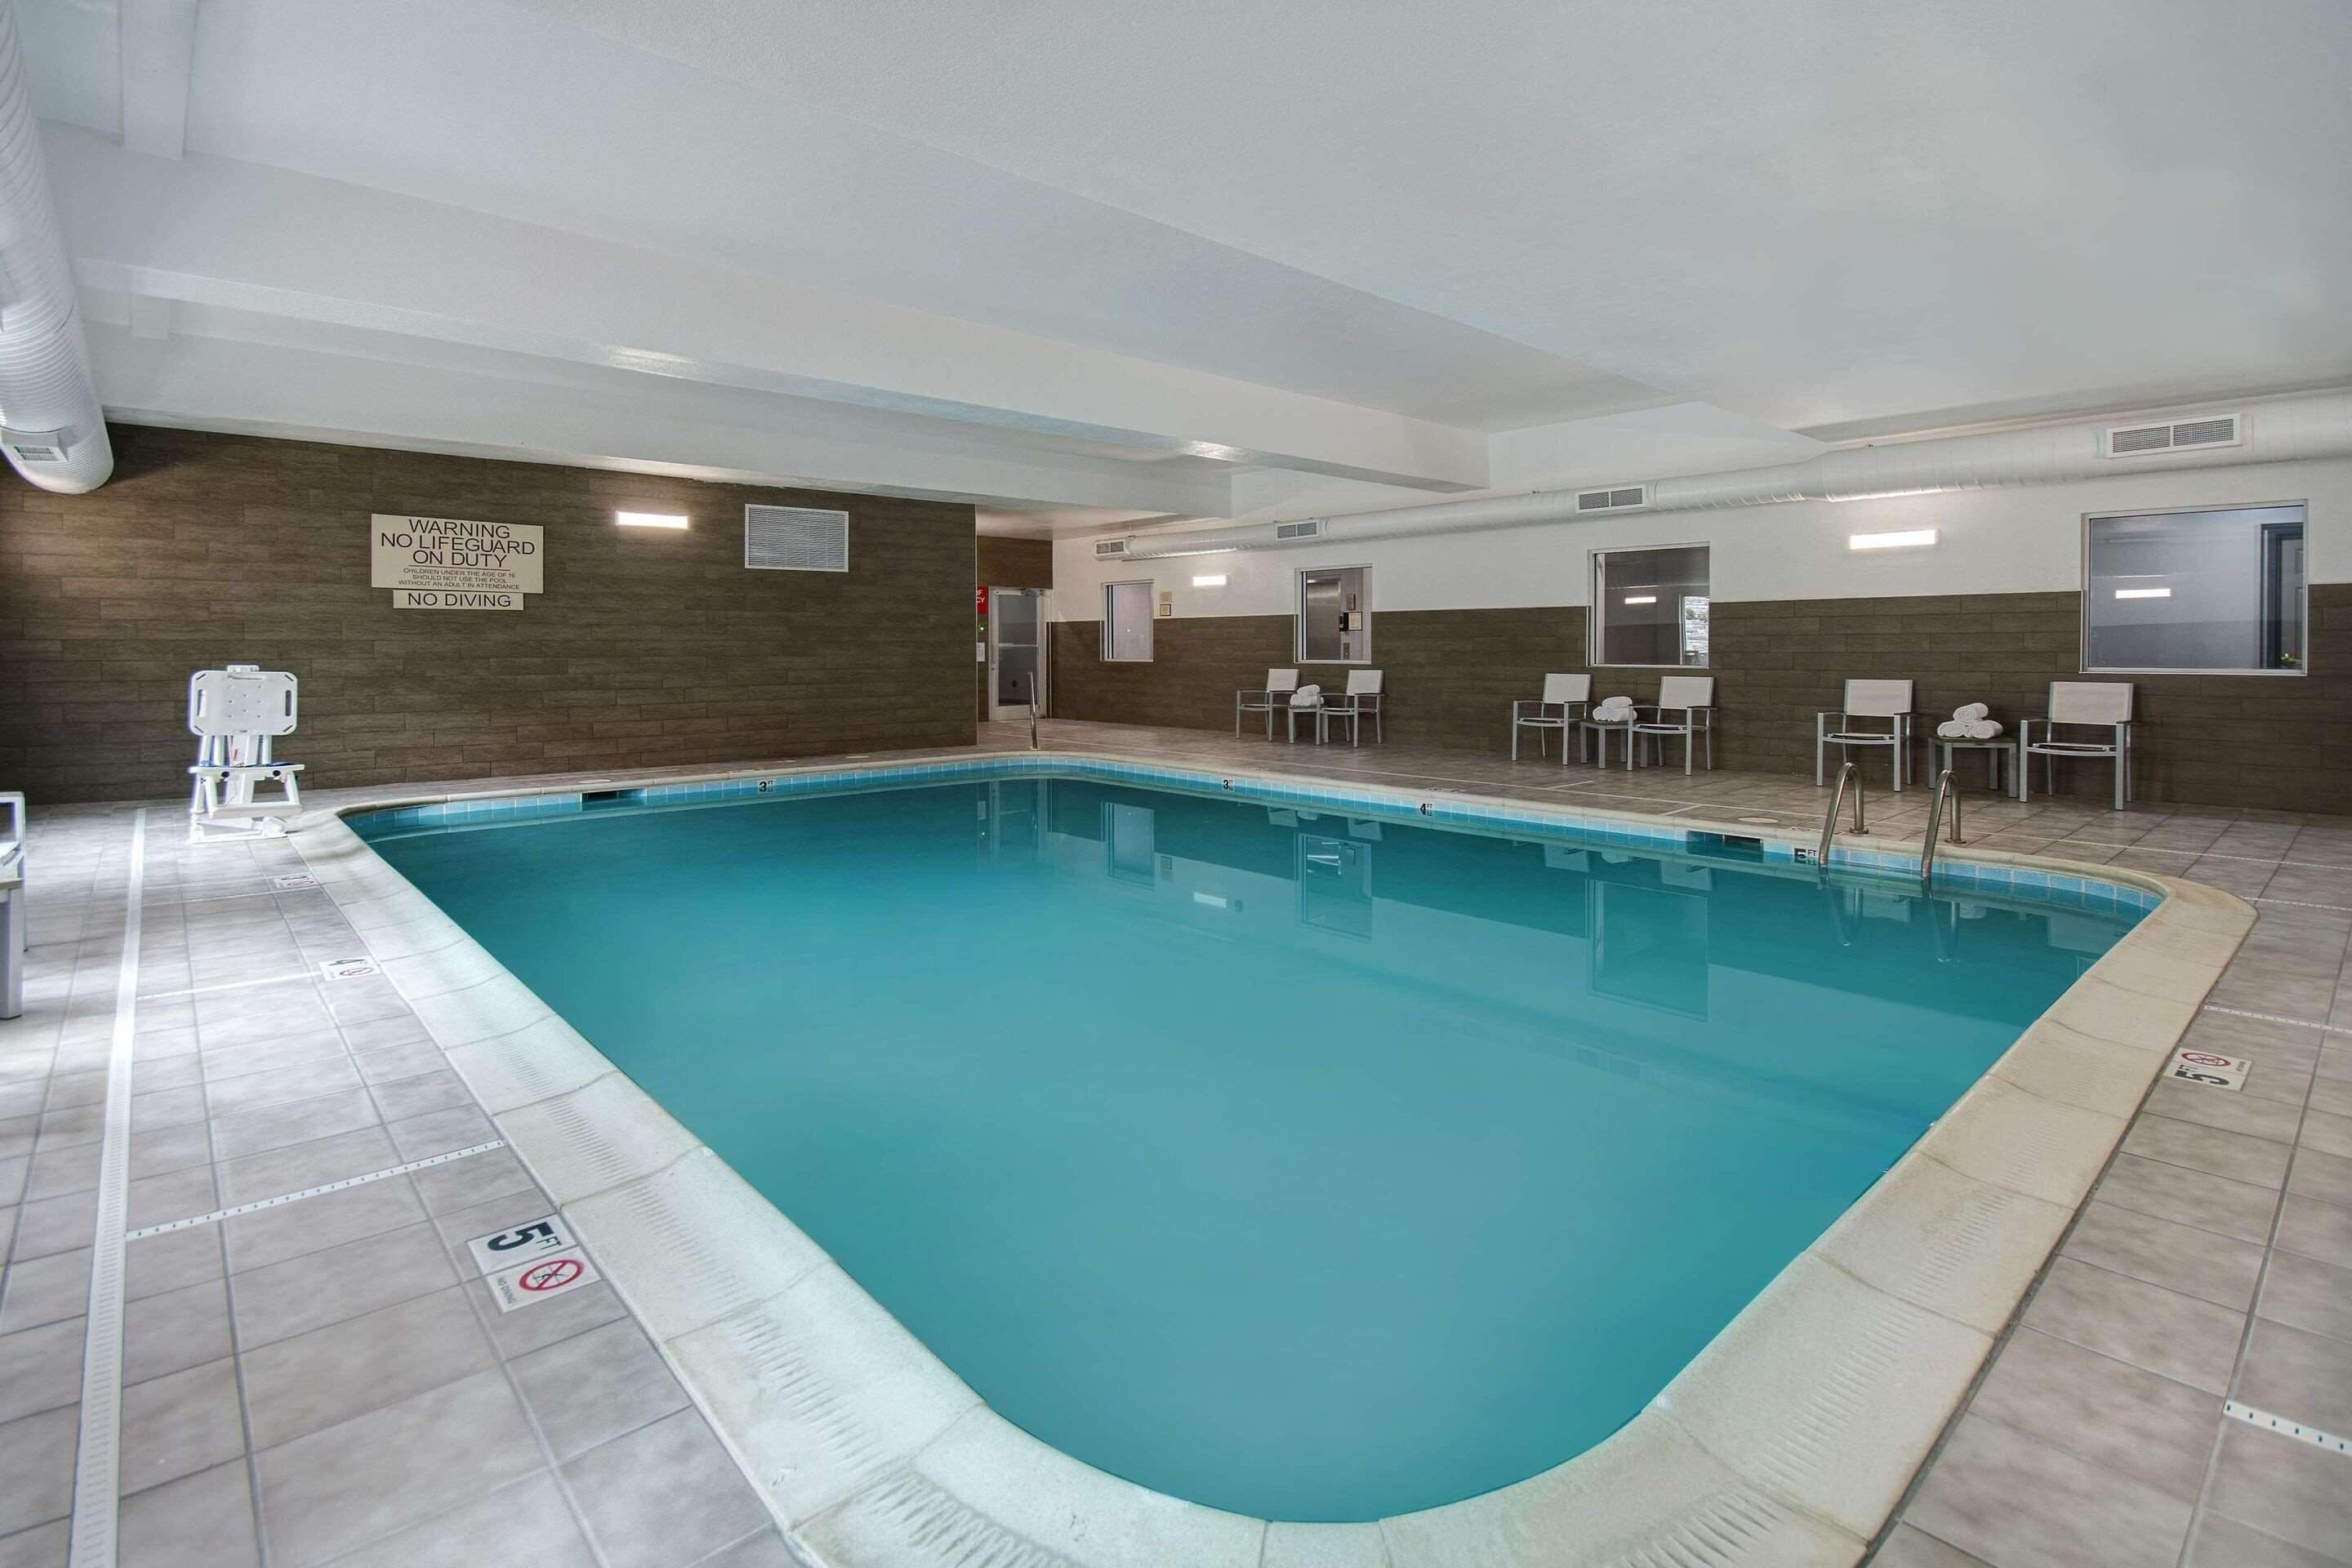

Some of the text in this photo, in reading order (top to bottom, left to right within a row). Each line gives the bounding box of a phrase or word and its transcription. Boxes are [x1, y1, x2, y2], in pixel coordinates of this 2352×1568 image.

[409, 519, 510, 539] WARNING
[381, 532, 536, 555] NO LIFEGUARD
[412, 550, 507, 568] ON DUTY
[476, 582, 520, 590] ATTENDANCE
[408, 592, 511, 608] NO DIVING
[2174, 1069, 2230, 1085] 5
[487, 1221, 563, 1252] 5 FT
